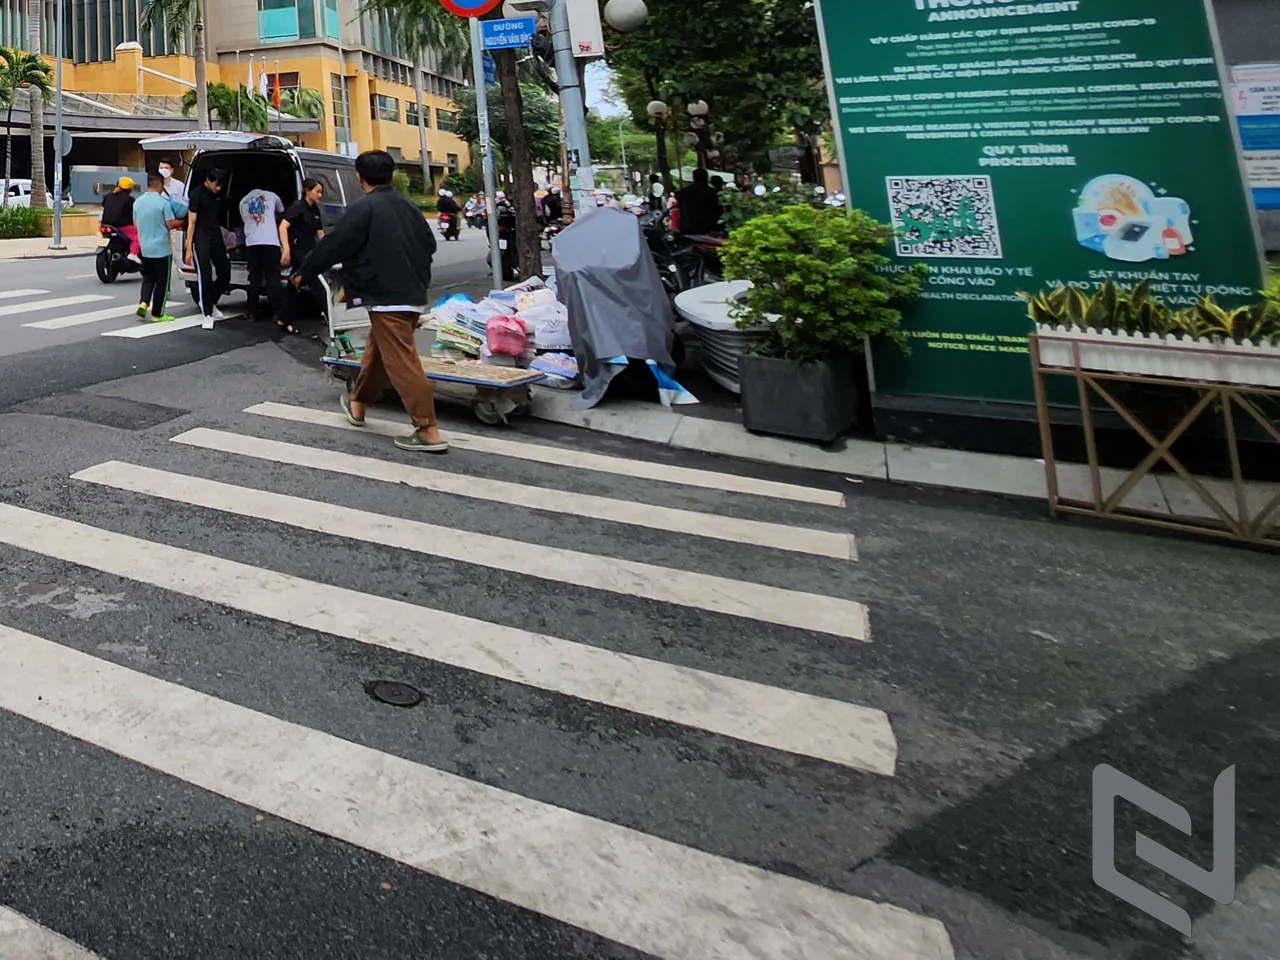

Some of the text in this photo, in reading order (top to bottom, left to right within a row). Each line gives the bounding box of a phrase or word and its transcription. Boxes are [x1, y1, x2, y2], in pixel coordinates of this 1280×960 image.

[927, 0, 1081, 23] ANNOUNCEMENT
[1103, 18, 1157, 29] COVID-19
[1156, 59, 1181, 68] QUY
[1034, 120, 1047, 128] TO
[1049, 118, 1096, 127] FOLLOW
[1167, 115, 1221, 124] COVID-19
[982, 145, 1016, 157] QUY
[978, 156, 1077, 167] PROCEDURE
[941, 265, 972, 275] KHAI
[974, 265, 1003, 276] BÁO
[1005, 268, 1017, 276] Y
[967, 276, 996, 287] VÀO
[1173, 272, 1200, 282] TAY
